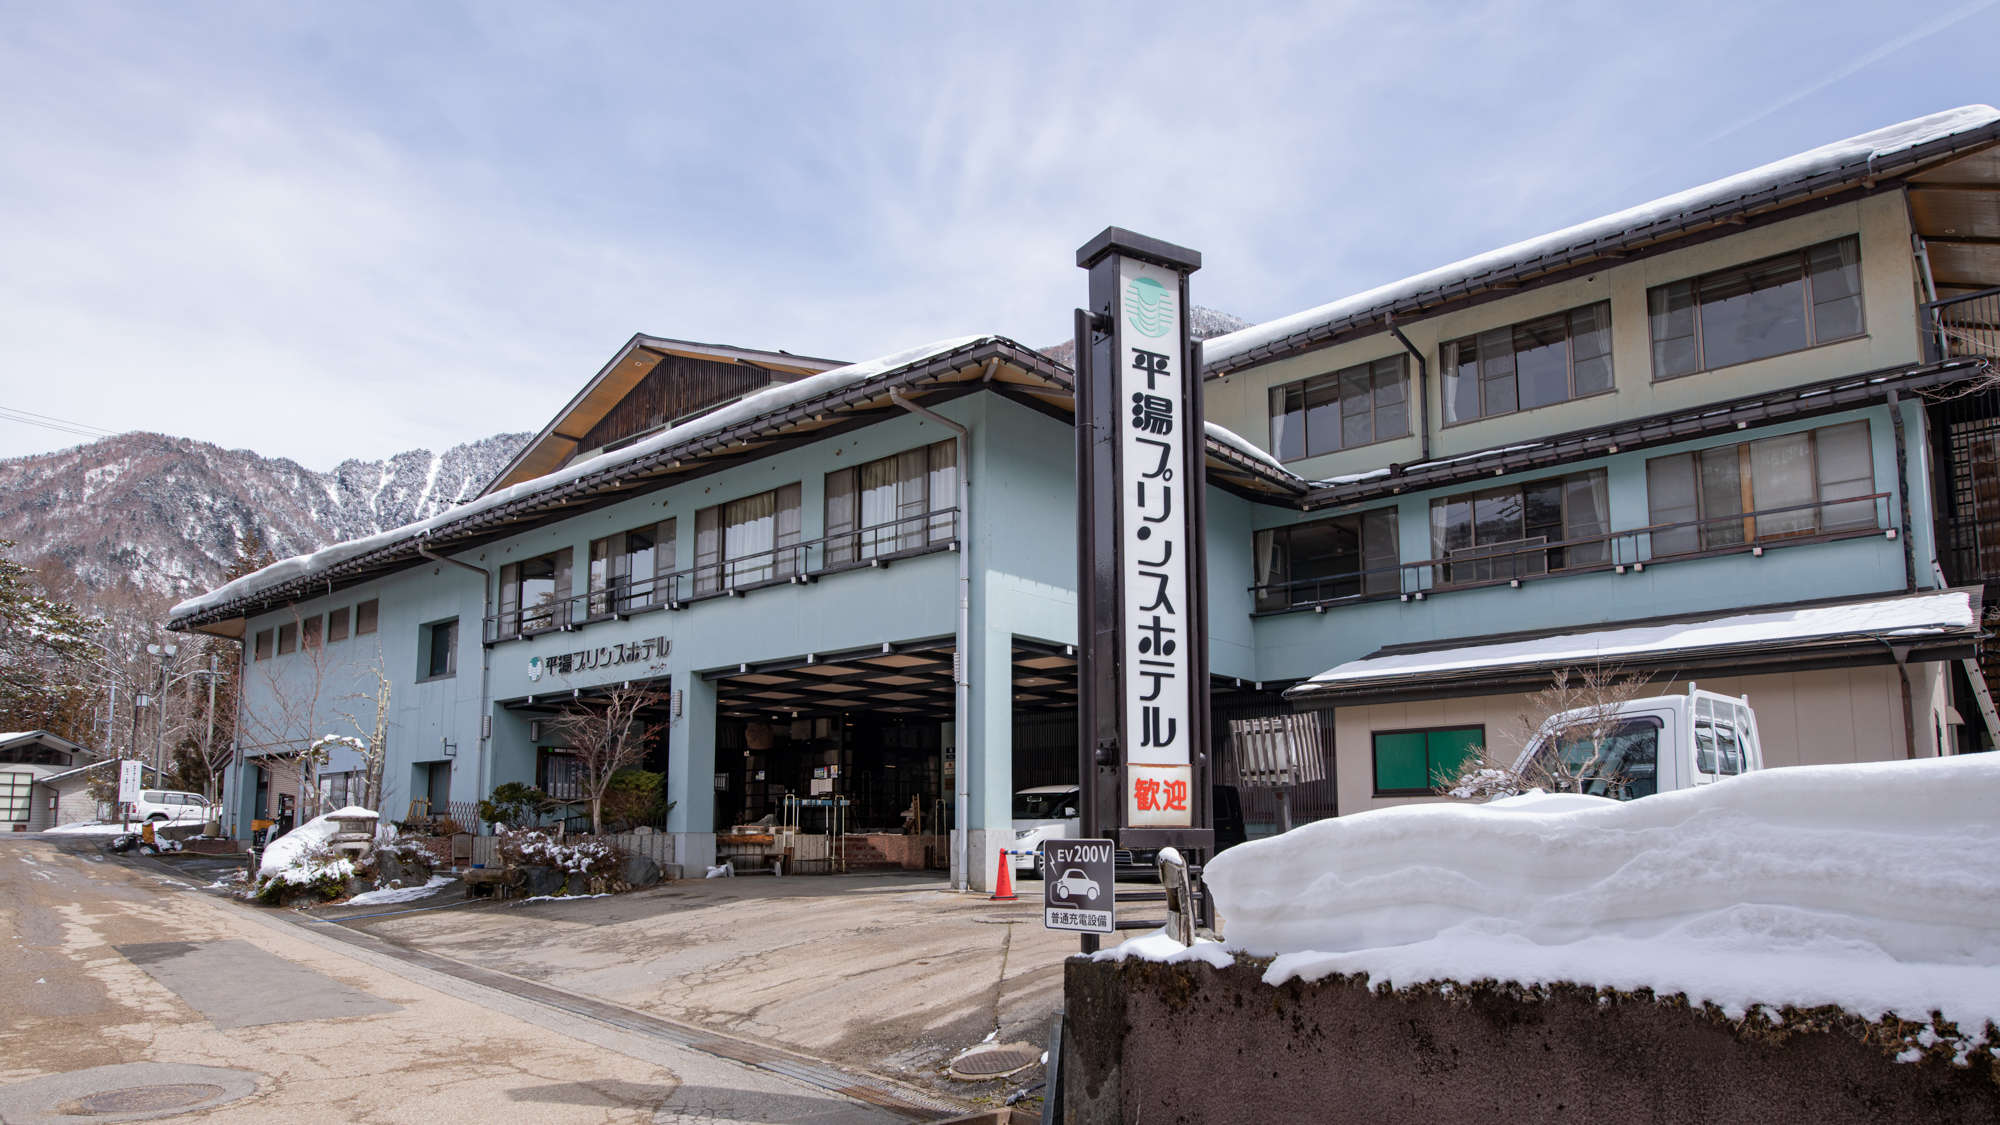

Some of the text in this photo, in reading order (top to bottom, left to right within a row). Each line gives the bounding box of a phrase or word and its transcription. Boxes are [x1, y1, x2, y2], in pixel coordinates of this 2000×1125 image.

[1132, 347, 1177, 748] 平湯プリンスホテル
[546, 635, 672, 676] 平湯プリンスホテル
[1134, 778, 1187, 811] 歓迎
[1051, 911, 1107, 927] 普通充電設備
